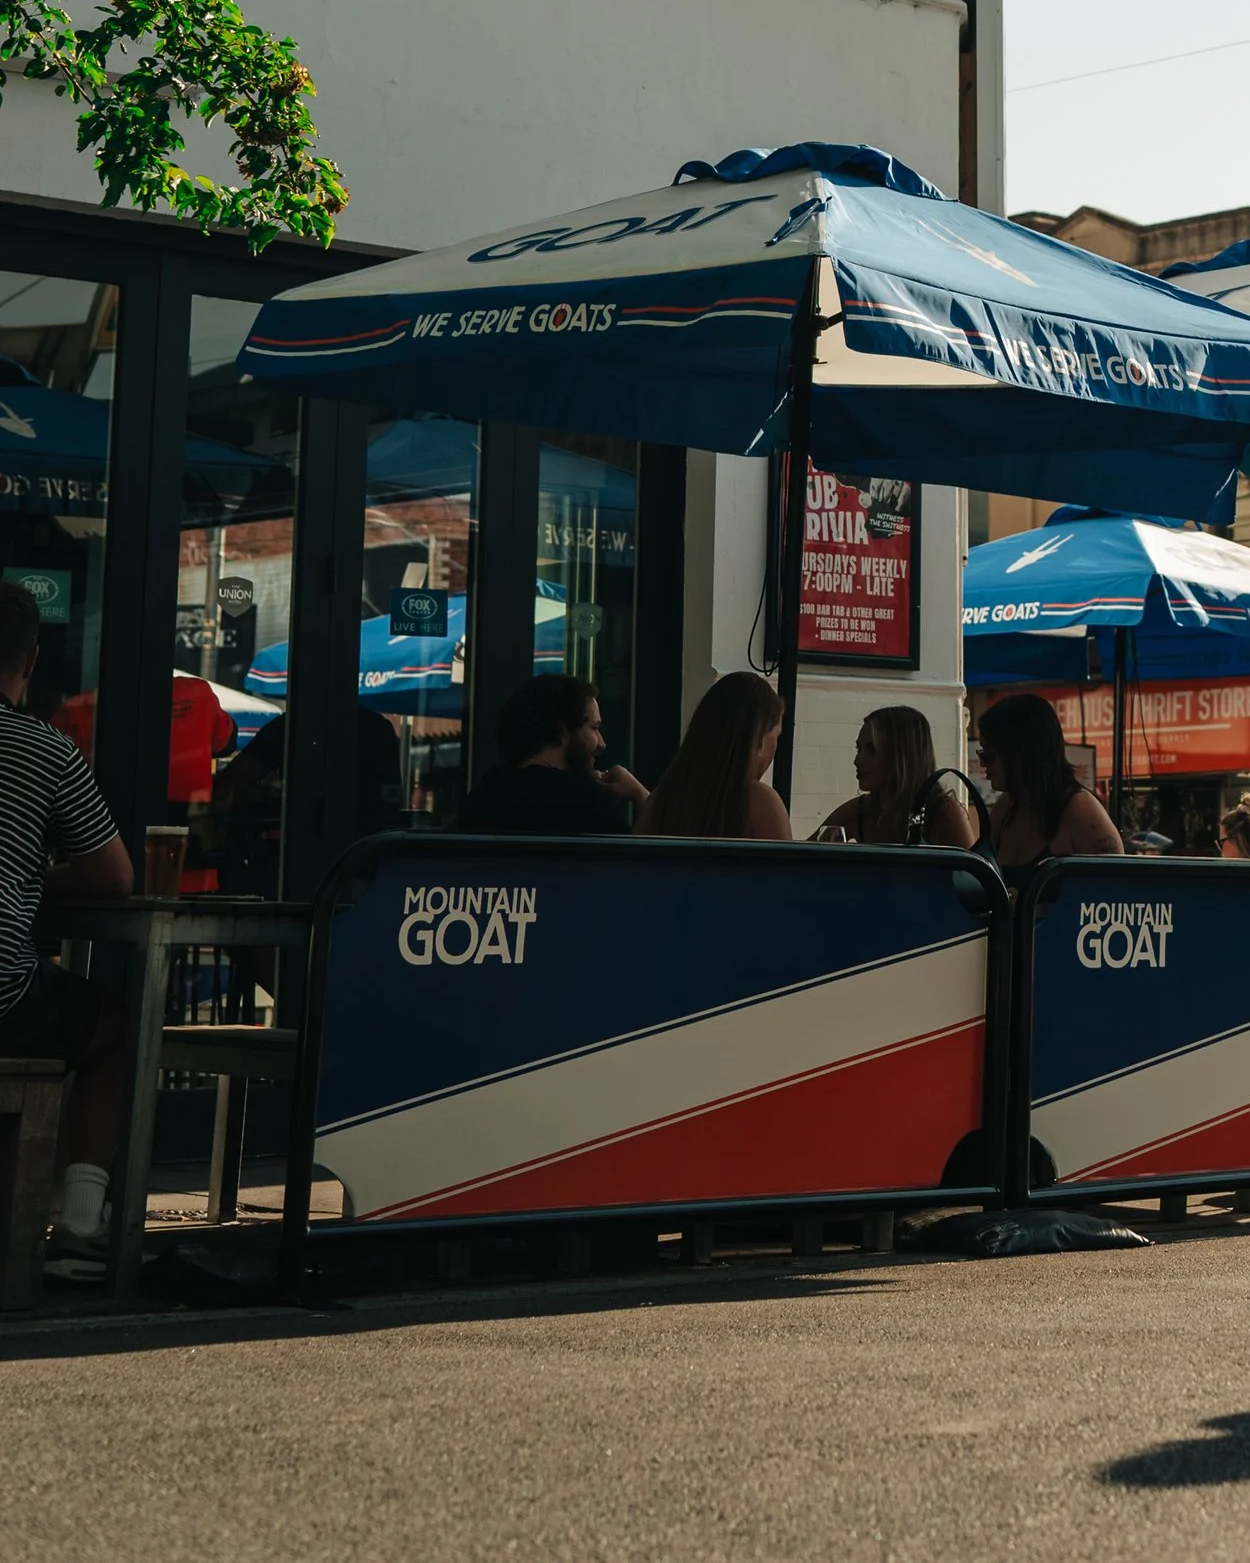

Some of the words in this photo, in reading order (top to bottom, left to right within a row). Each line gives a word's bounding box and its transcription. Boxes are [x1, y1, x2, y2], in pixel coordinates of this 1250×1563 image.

[466, 194, 778, 263] GOAT
[412, 312, 452, 338] WE
[452, 306, 526, 338] SERVE
[529, 303, 617, 333] GOATS
[1036, 344, 1105, 381] SERVE
[1106, 355, 1185, 392] GOATS
[806, 475, 839, 510] UB
[805, 511, 869, 545] RIVIA
[802, 552, 857, 575] URSDAYS
[861, 556, 908, 578] WEEKLY
[24, 580, 50, 593] FOX
[218, 587, 252, 600] UNION
[803, 571, 853, 594] 7:00PM
[866, 576, 894, 597] LATE
[408, 598, 431, 611] FOX
[816, 604, 831, 615] BAR
[832, 605, 845, 616] TAB
[852, 606, 873, 618] OTHER
[874, 608, 895, 620] GREAT
[961, 606, 990, 625] RVE
[991, 601, 1041, 623] GOATS
[393, 621, 416, 632] LIVE
[815, 616, 839, 629] PRIZES
[840, 618, 849, 629] TO
[850, 619, 859, 630] BE
[861, 619, 876, 631] WON
[820, 629, 844, 642] DINNER
[845, 631, 877, 643] SPECIALS
[1054, 695, 1114, 729] EHOUS
[403, 886, 537, 915] MOUNTAIN
[1080, 902, 1173, 926] MOUNTAIN
[398, 911, 537, 966] GOAT
[1076, 923, 1174, 969] GOAT
